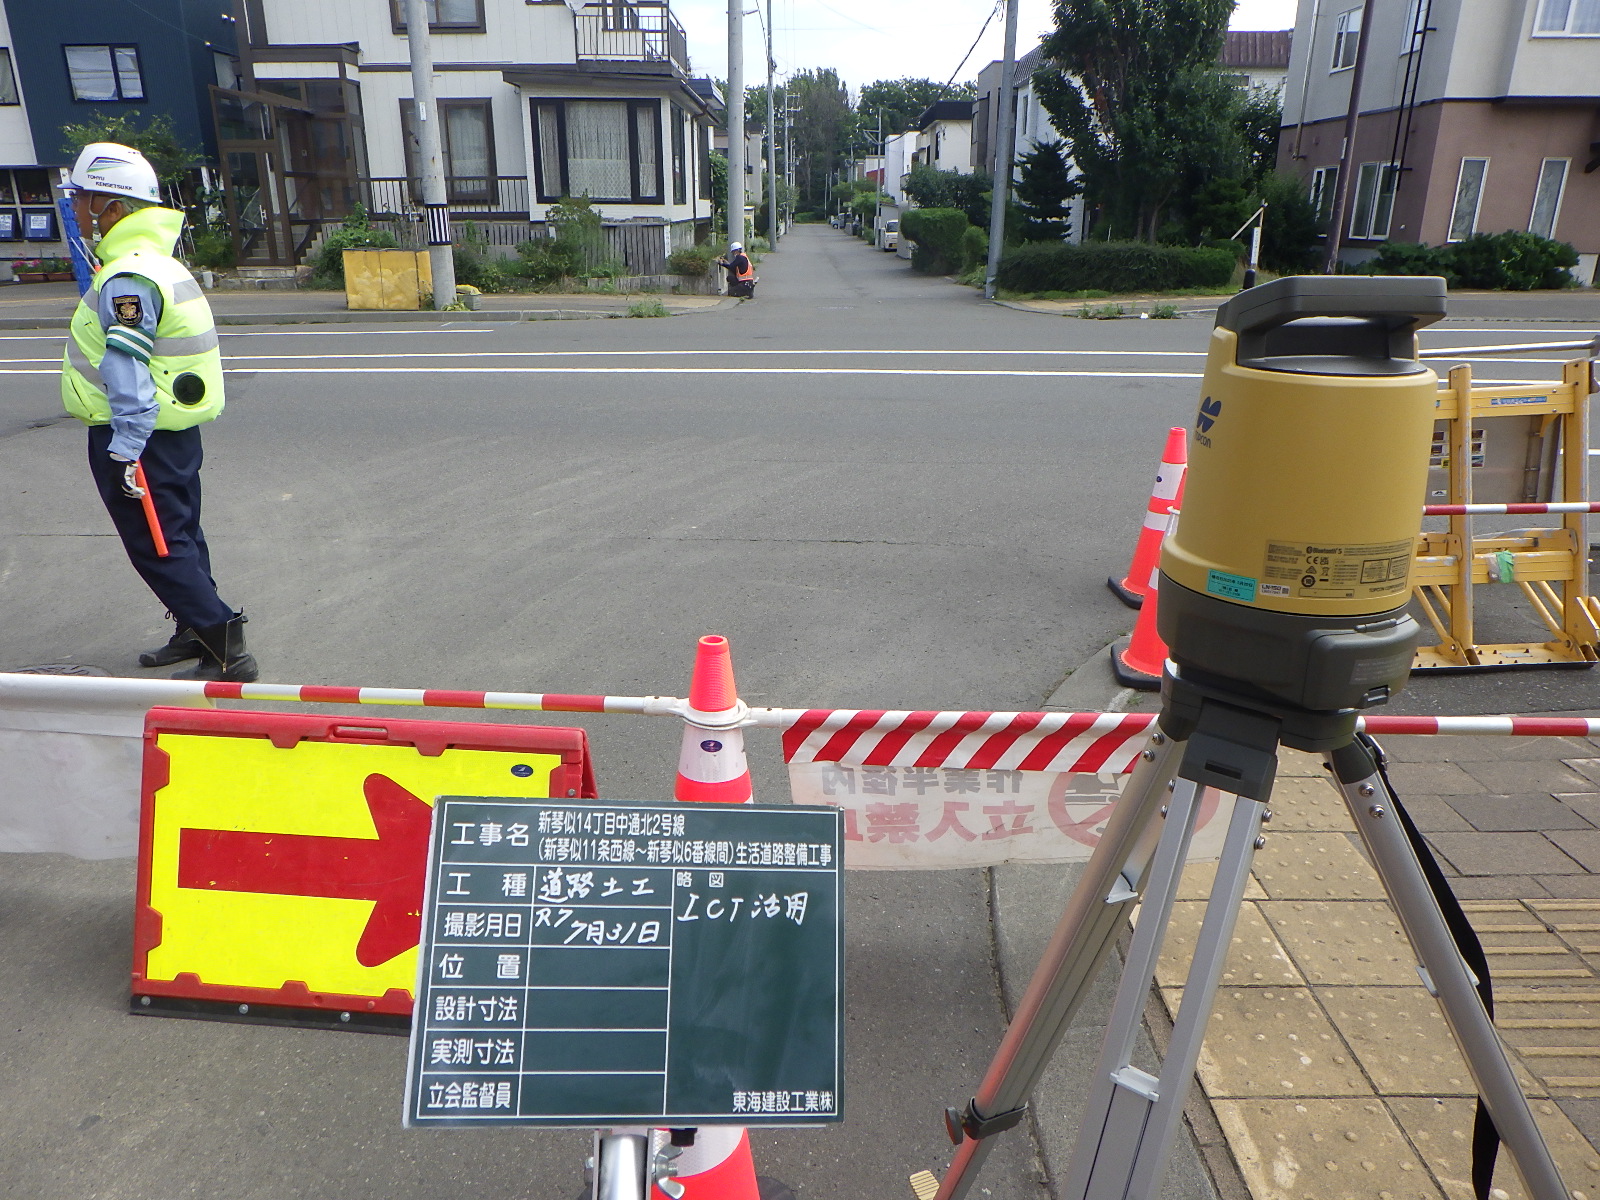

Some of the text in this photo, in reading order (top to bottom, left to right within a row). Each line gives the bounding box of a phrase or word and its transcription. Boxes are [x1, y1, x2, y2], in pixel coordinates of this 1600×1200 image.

[451, 822, 529, 847] 工事名
[538, 810, 685, 837] 新琴似14丁目中通北2号線
[443, 912, 522, 938] 撮影月日
[435, 995, 518, 1022] 設計寸法
[430, 1038, 515, 1065] 実測寸法
[427, 1081, 511, 1109] 立会監督員
